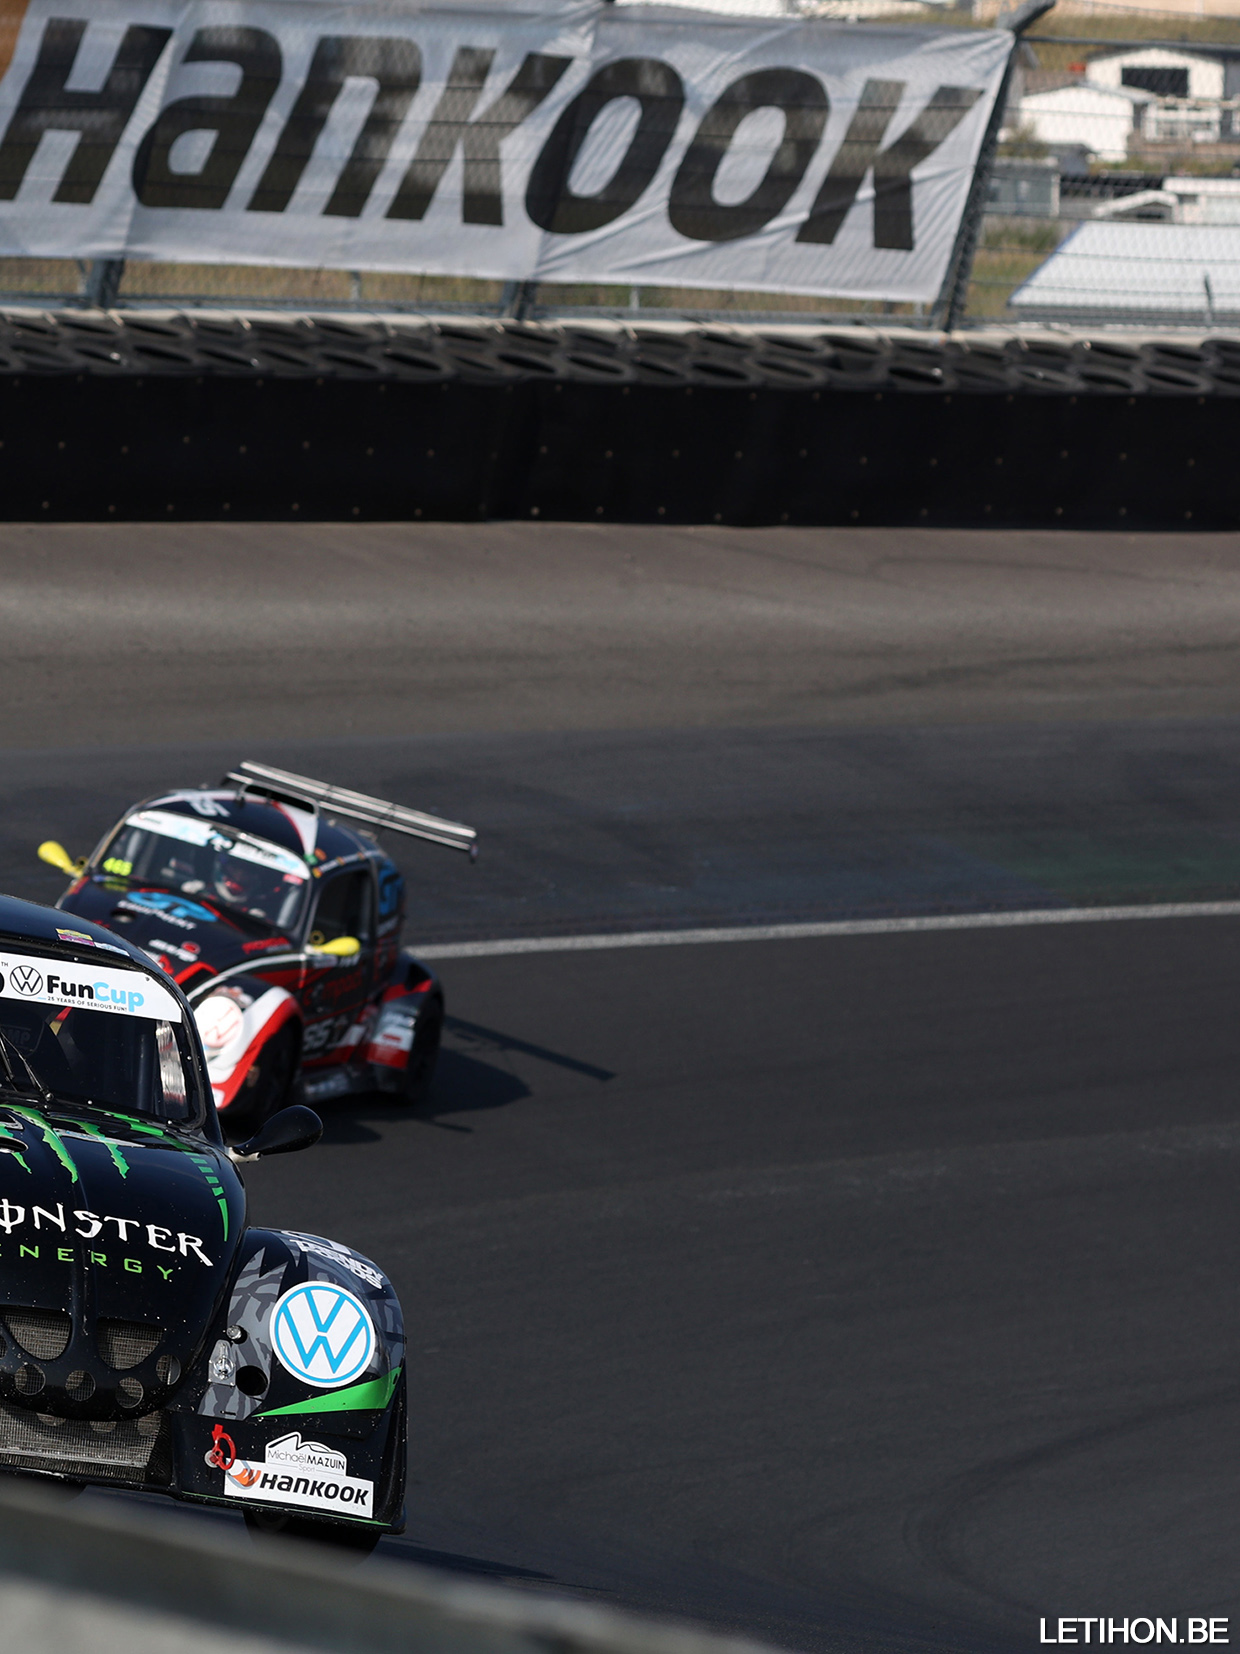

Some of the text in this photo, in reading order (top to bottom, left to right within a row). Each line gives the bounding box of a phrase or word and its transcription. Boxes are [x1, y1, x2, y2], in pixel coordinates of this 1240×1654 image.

[46, 974, 145, 1012] FunCup
[56, 996, 76, 1005] YEARS
[86, 1000, 112, 1010] SERIOUS
[113, 1004, 128, 1012] FUN!
[298, 1463, 316, 1473] Sport
[307, 1455, 345, 1470] MAZUIN
